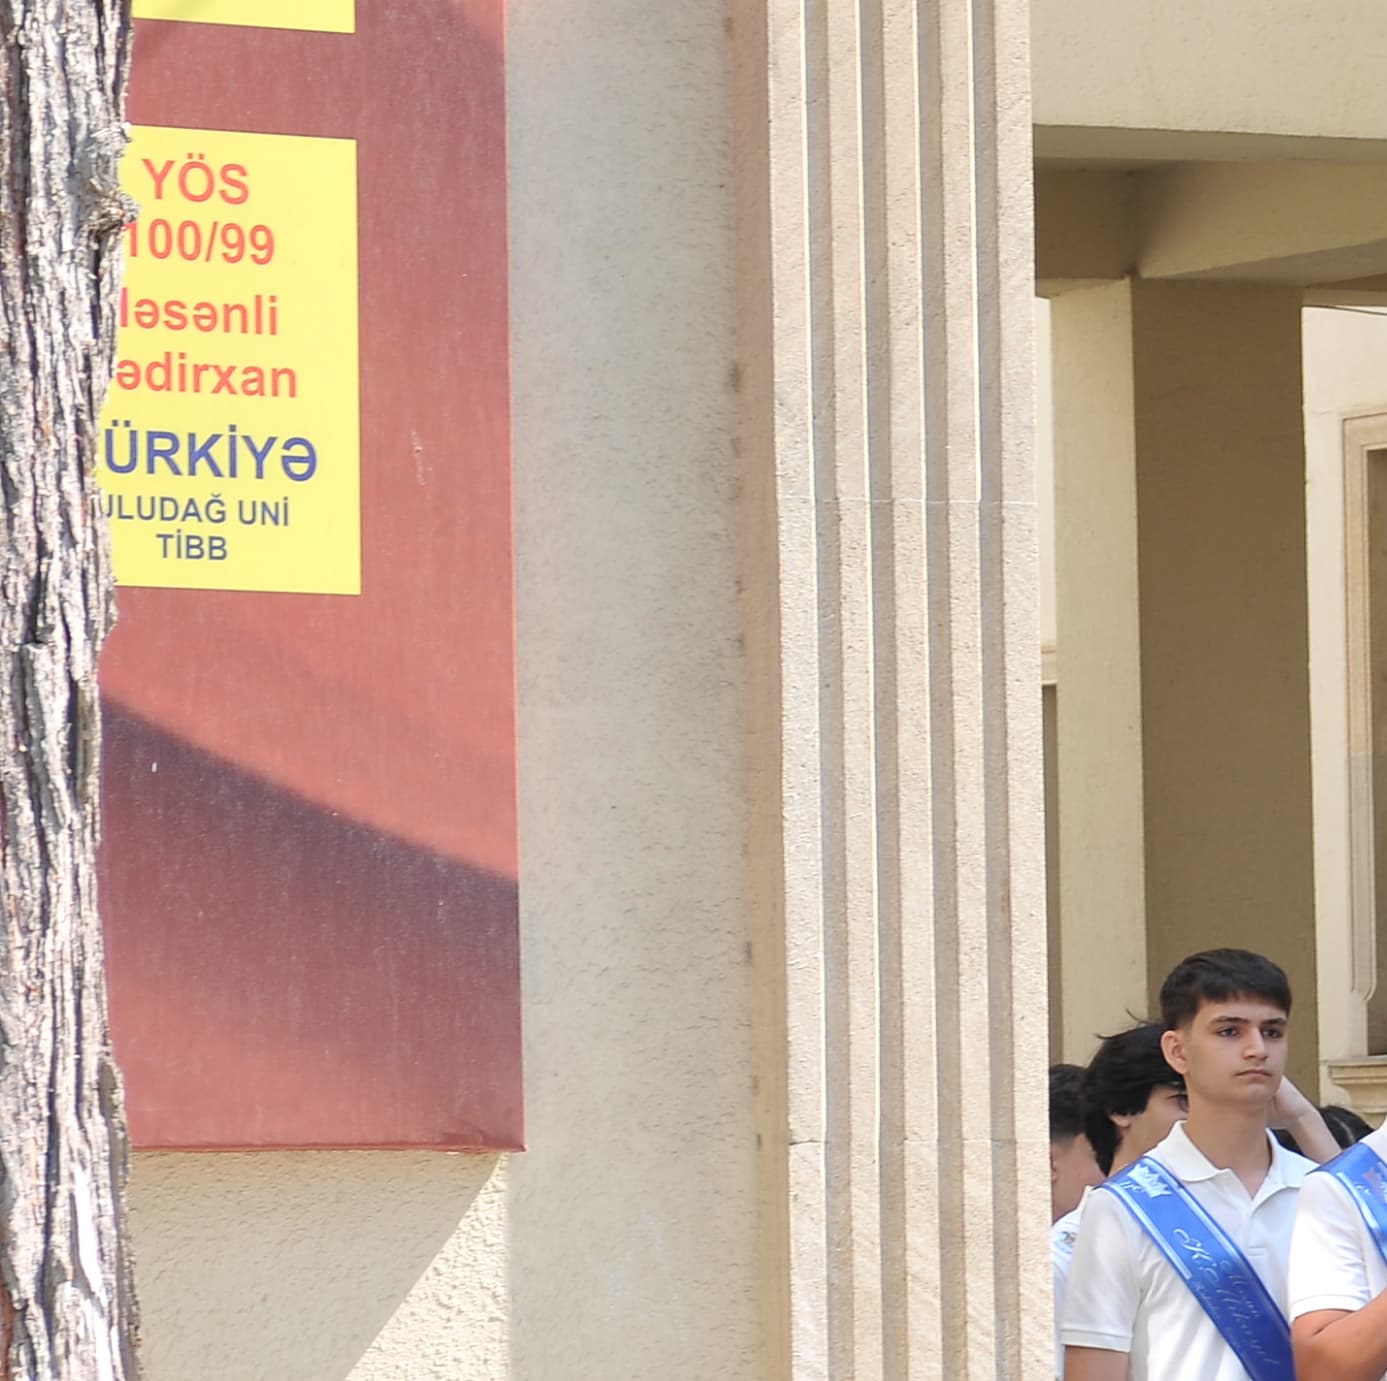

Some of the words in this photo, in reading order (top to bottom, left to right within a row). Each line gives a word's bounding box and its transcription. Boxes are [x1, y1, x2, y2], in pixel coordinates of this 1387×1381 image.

[141, 153, 250, 205] YÖS
[124, 218, 275, 265] 100/99
[119, 287, 278, 336] əsənli
[112, 351, 297, 398] ədirxan
[104, 419, 317, 482] ÜRKİYƏ
[238, 496, 289, 526] UNİ
[155, 529, 228, 560] TİBB
